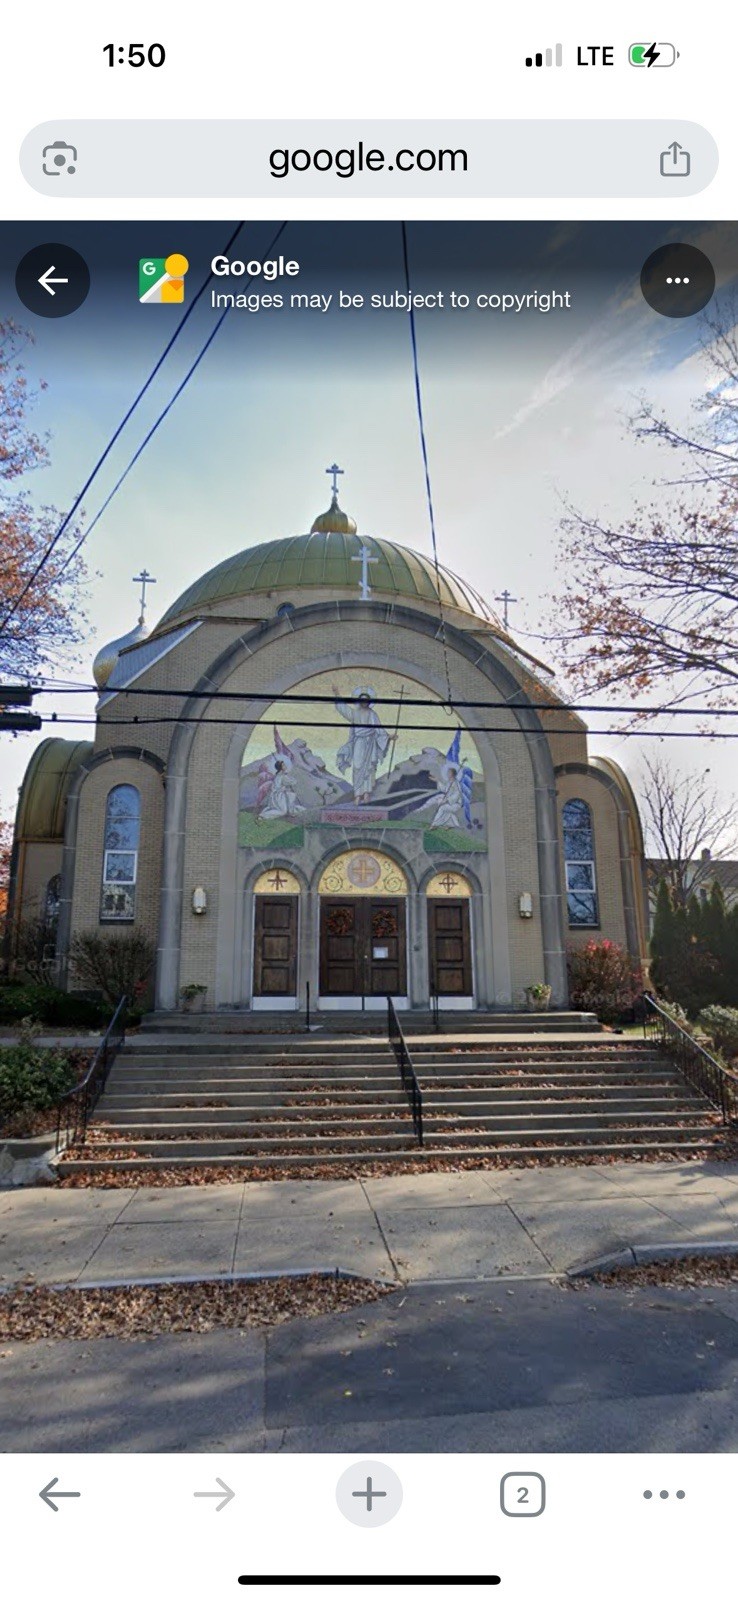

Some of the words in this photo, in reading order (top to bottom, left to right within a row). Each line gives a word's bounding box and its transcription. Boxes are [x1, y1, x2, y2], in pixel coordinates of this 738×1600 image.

[102, 42, 166, 68] 1:50
[577, 46, 614, 66] LTE
[269, 141, 468, 179] google.com
[142, 261, 157, 276] G
[210, 255, 300, 281] Google
[211, 290, 284, 312] Images
[290, 294, 333, 312] may
[339, 290, 364, 308] be
[370, 290, 444, 312] subject
[449, 292, 470, 308] to
[476, 290, 571, 312] copyright
[516, 1486, 530, 1504] 2
